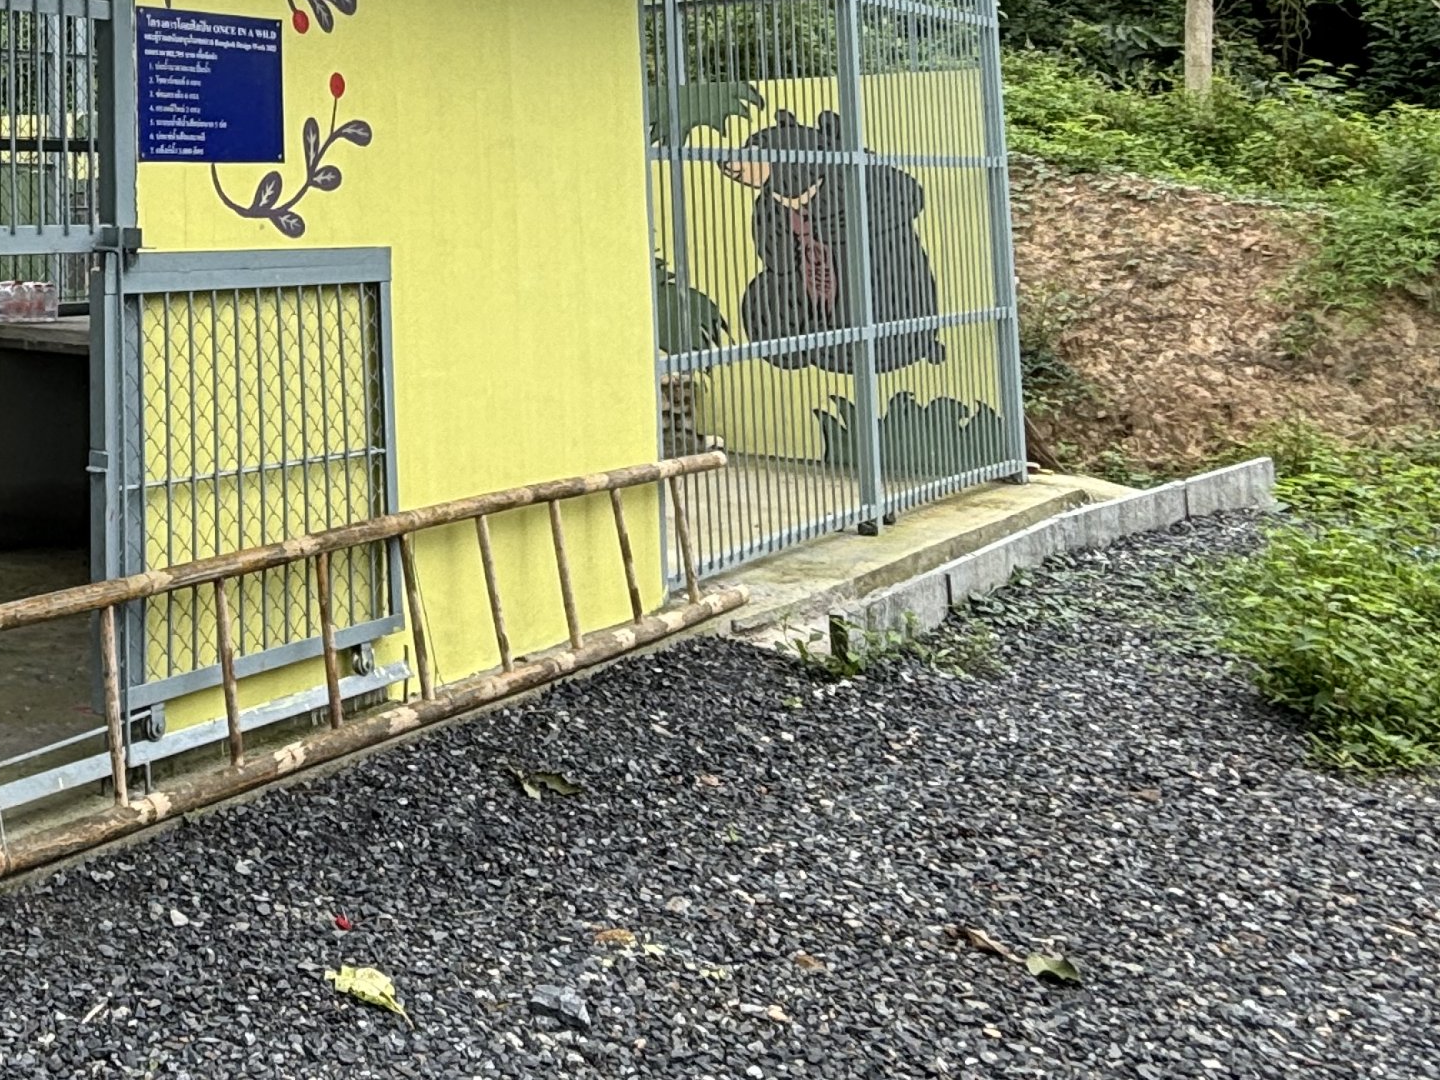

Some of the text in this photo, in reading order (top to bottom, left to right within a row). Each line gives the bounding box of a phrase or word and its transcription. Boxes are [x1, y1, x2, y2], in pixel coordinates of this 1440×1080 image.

[212, 24, 237, 36] ONCE
[237, 27, 247, 37] IN
[248, 29, 254, 38] A
[255, 29, 277, 40] WILD
